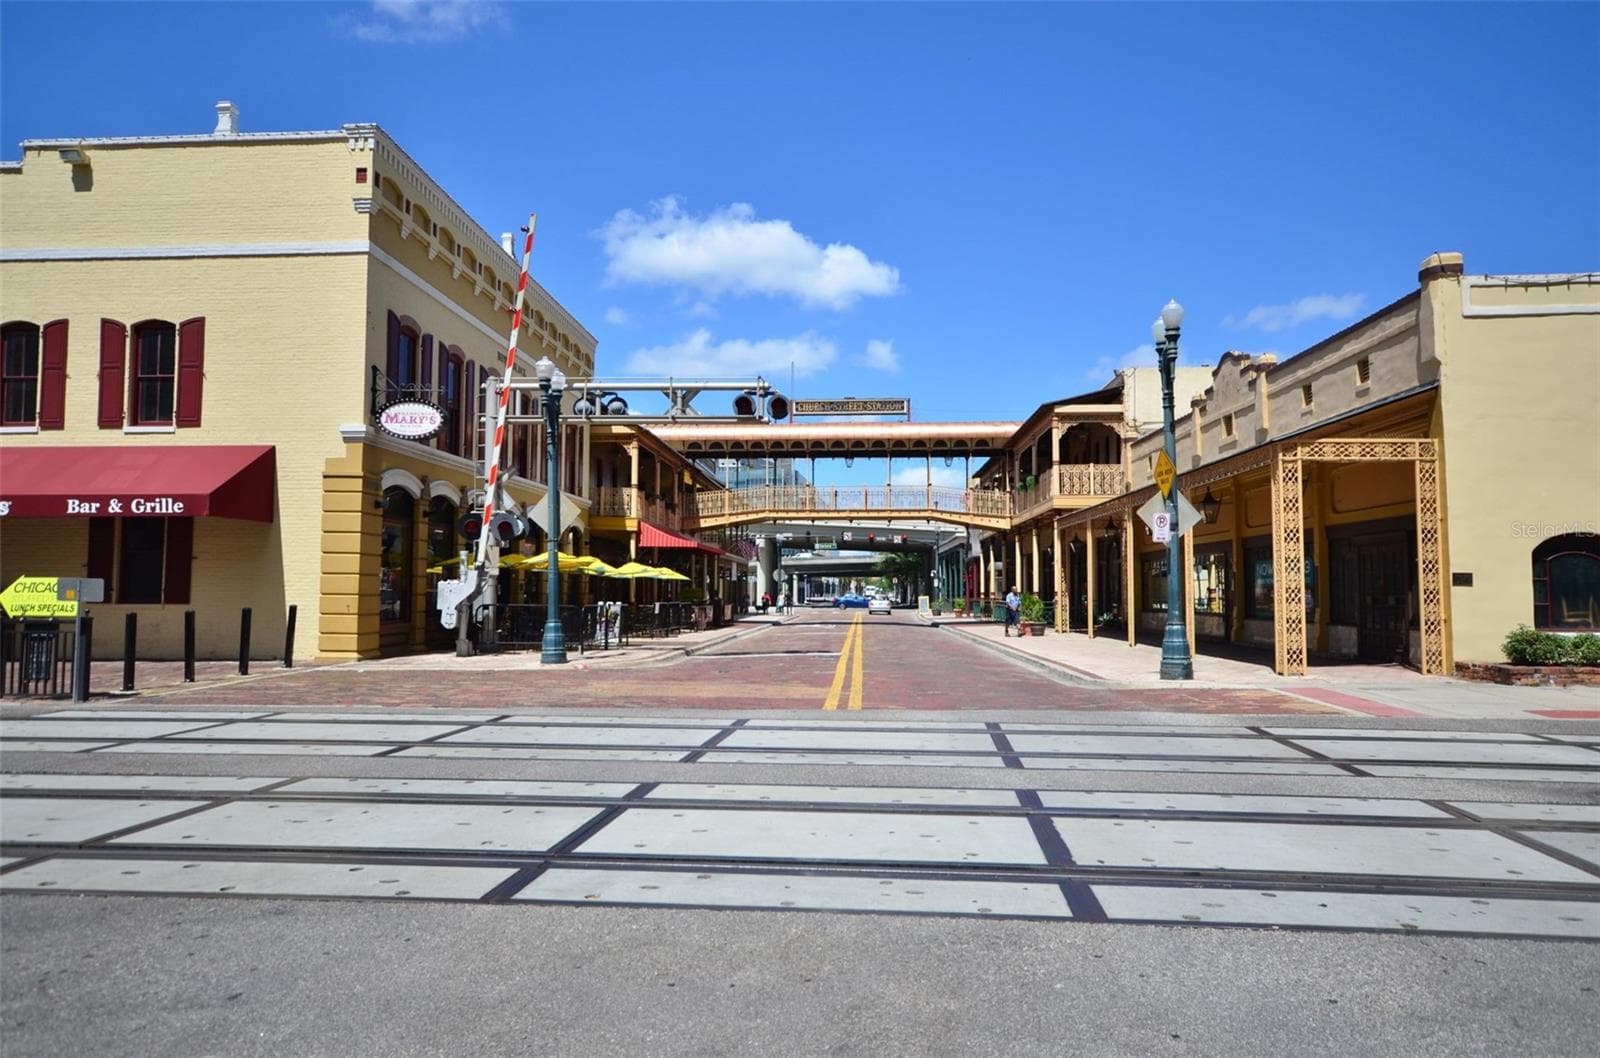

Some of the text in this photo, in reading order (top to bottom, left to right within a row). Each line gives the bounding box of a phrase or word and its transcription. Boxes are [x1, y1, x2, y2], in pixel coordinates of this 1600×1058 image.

[798, 401, 903, 412] CHURCH STREET STATION
[384, 412, 437, 425] MARY'S
[66, 498, 185, 514] Bar & Grille
[10, 603, 75, 612] LUNCH SPECIALS
